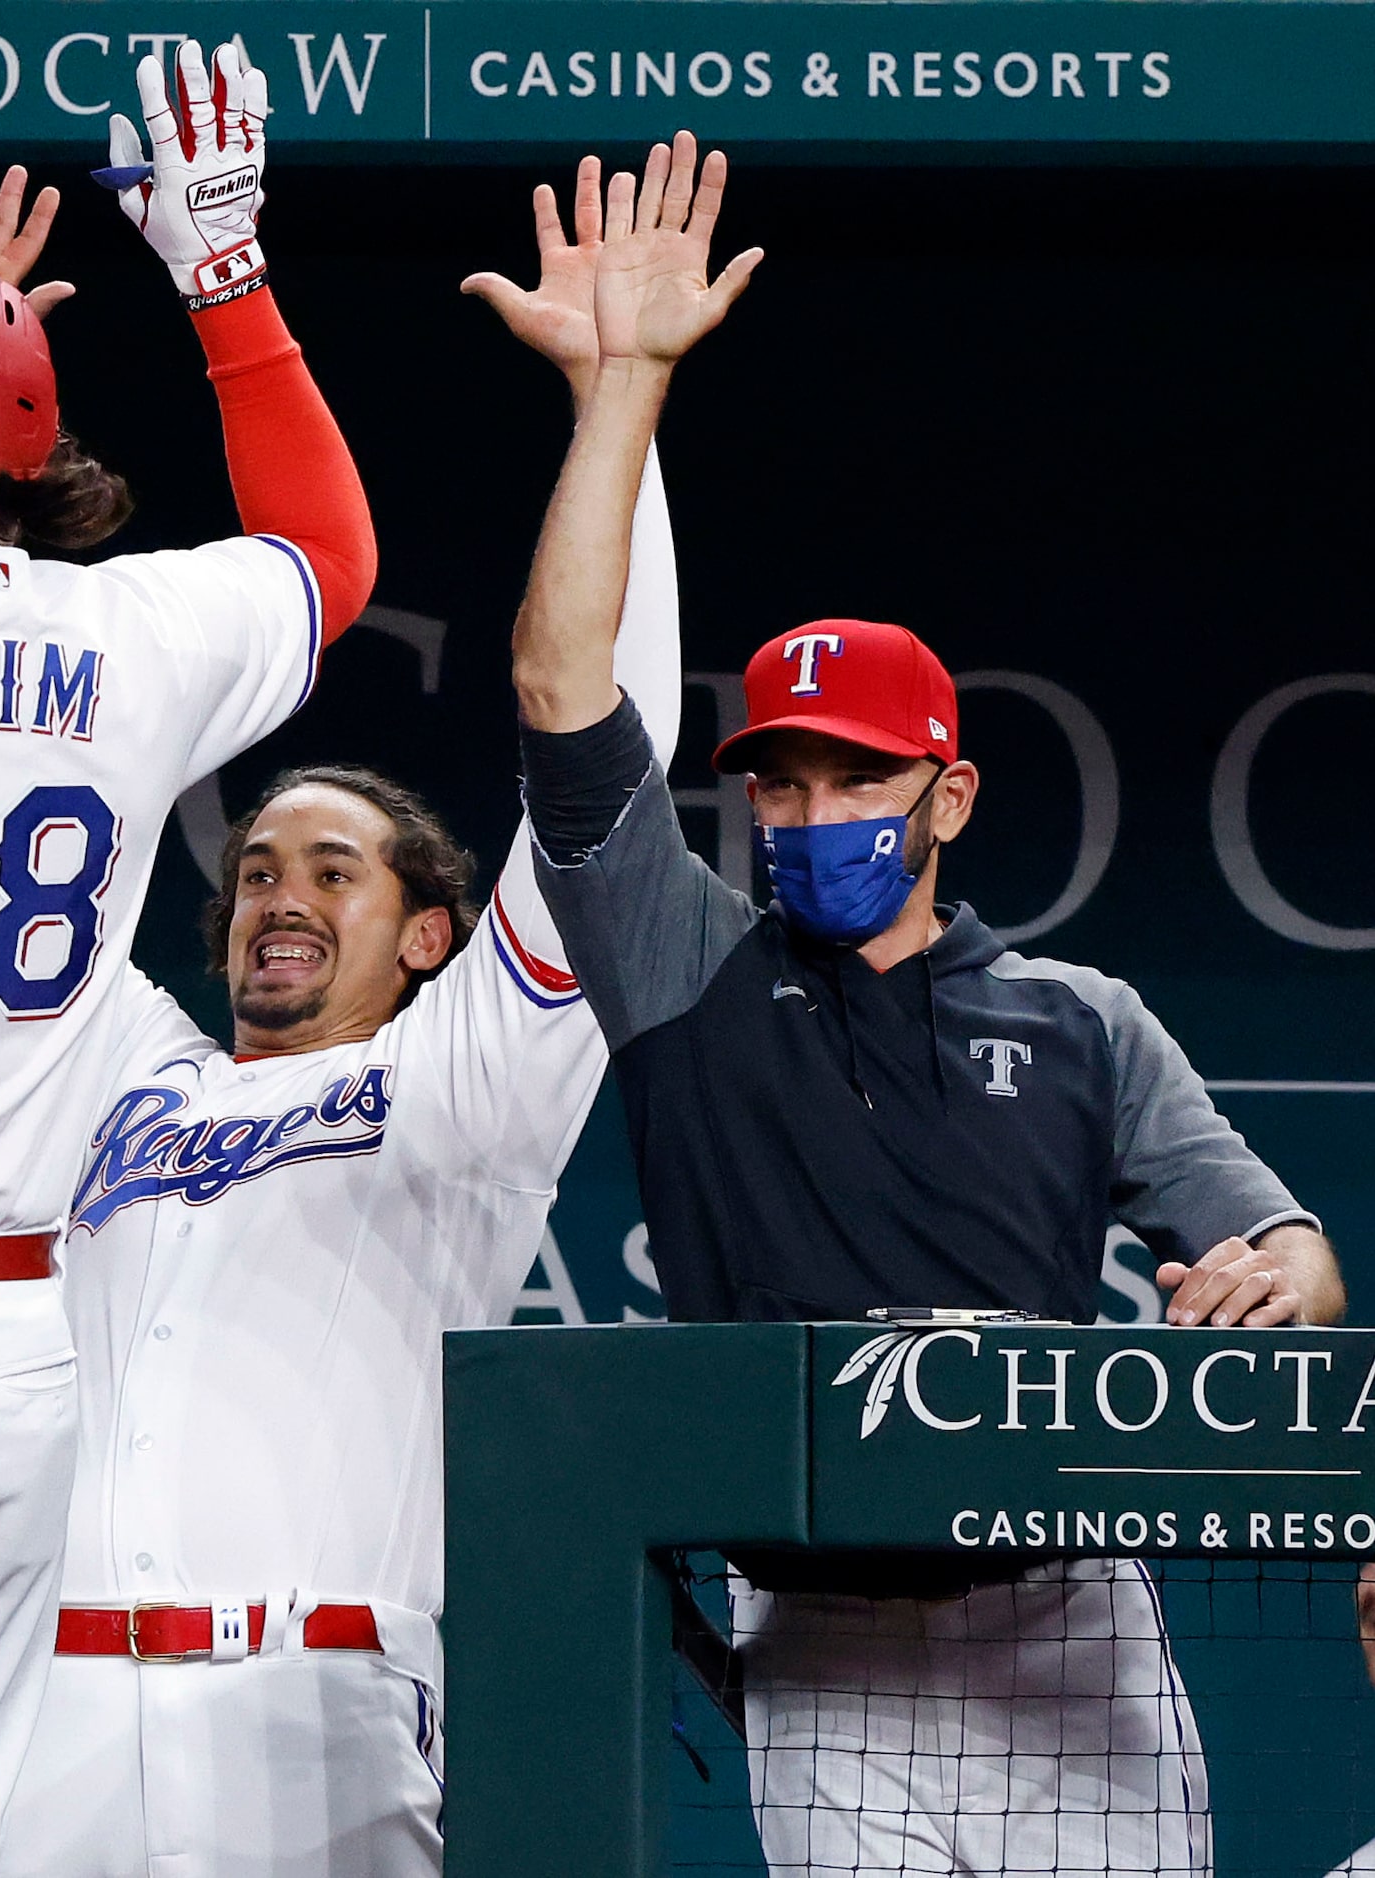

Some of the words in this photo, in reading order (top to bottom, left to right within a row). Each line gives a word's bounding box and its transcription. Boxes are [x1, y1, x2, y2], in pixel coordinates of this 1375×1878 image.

[470, 51, 773, 97] CASINOS
[802, 51, 839, 97] &
[868, 51, 1170, 98] RESORTS
[782, 633, 844, 697] T
[969, 1037, 1033, 1098] T
[950, 1509, 1178, 1548] CASINOS
[1199, 1512, 1229, 1549] &
[1249, 1512, 1375, 1550] RESO
[219, 1607, 240, 1640] 11
